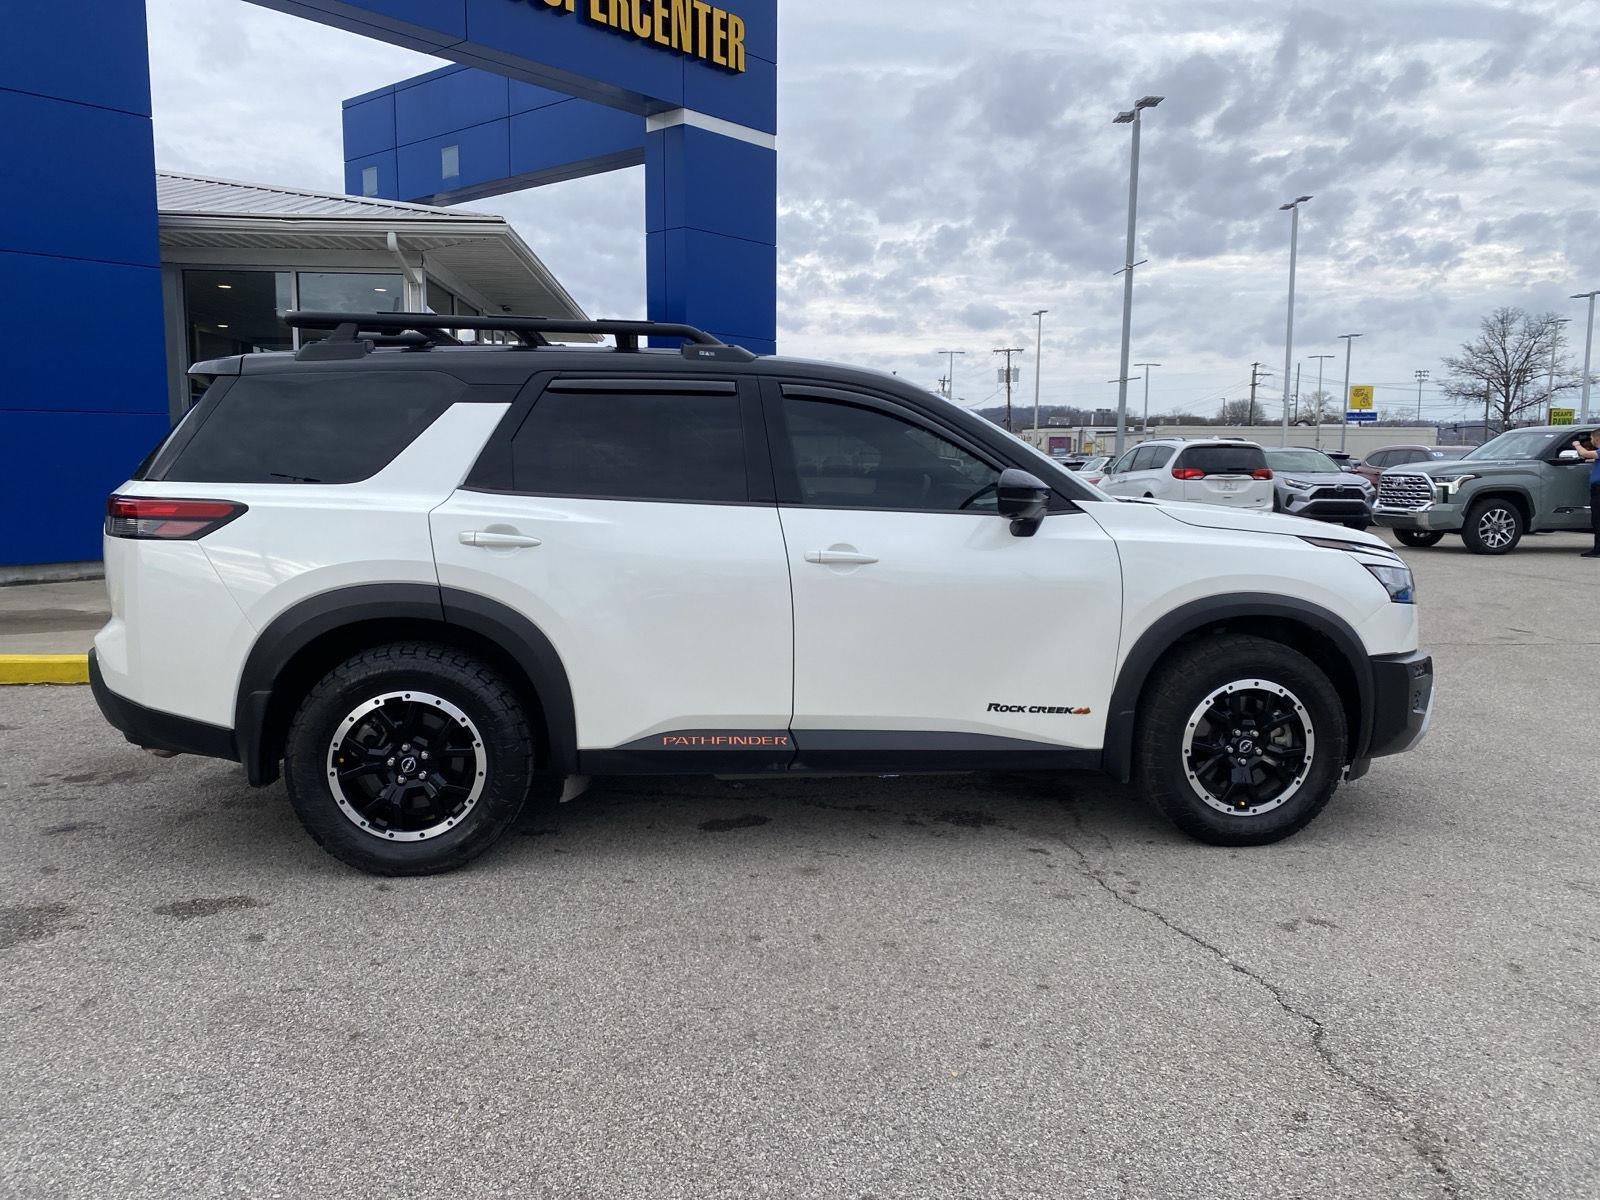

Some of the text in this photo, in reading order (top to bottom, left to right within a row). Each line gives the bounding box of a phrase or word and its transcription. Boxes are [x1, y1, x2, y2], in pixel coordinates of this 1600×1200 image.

[544, 0, 746, 72] RCENTER
[987, 703, 1075, 715] ROCK CREEK
[663, 736, 788, 746] PATHFINDER
